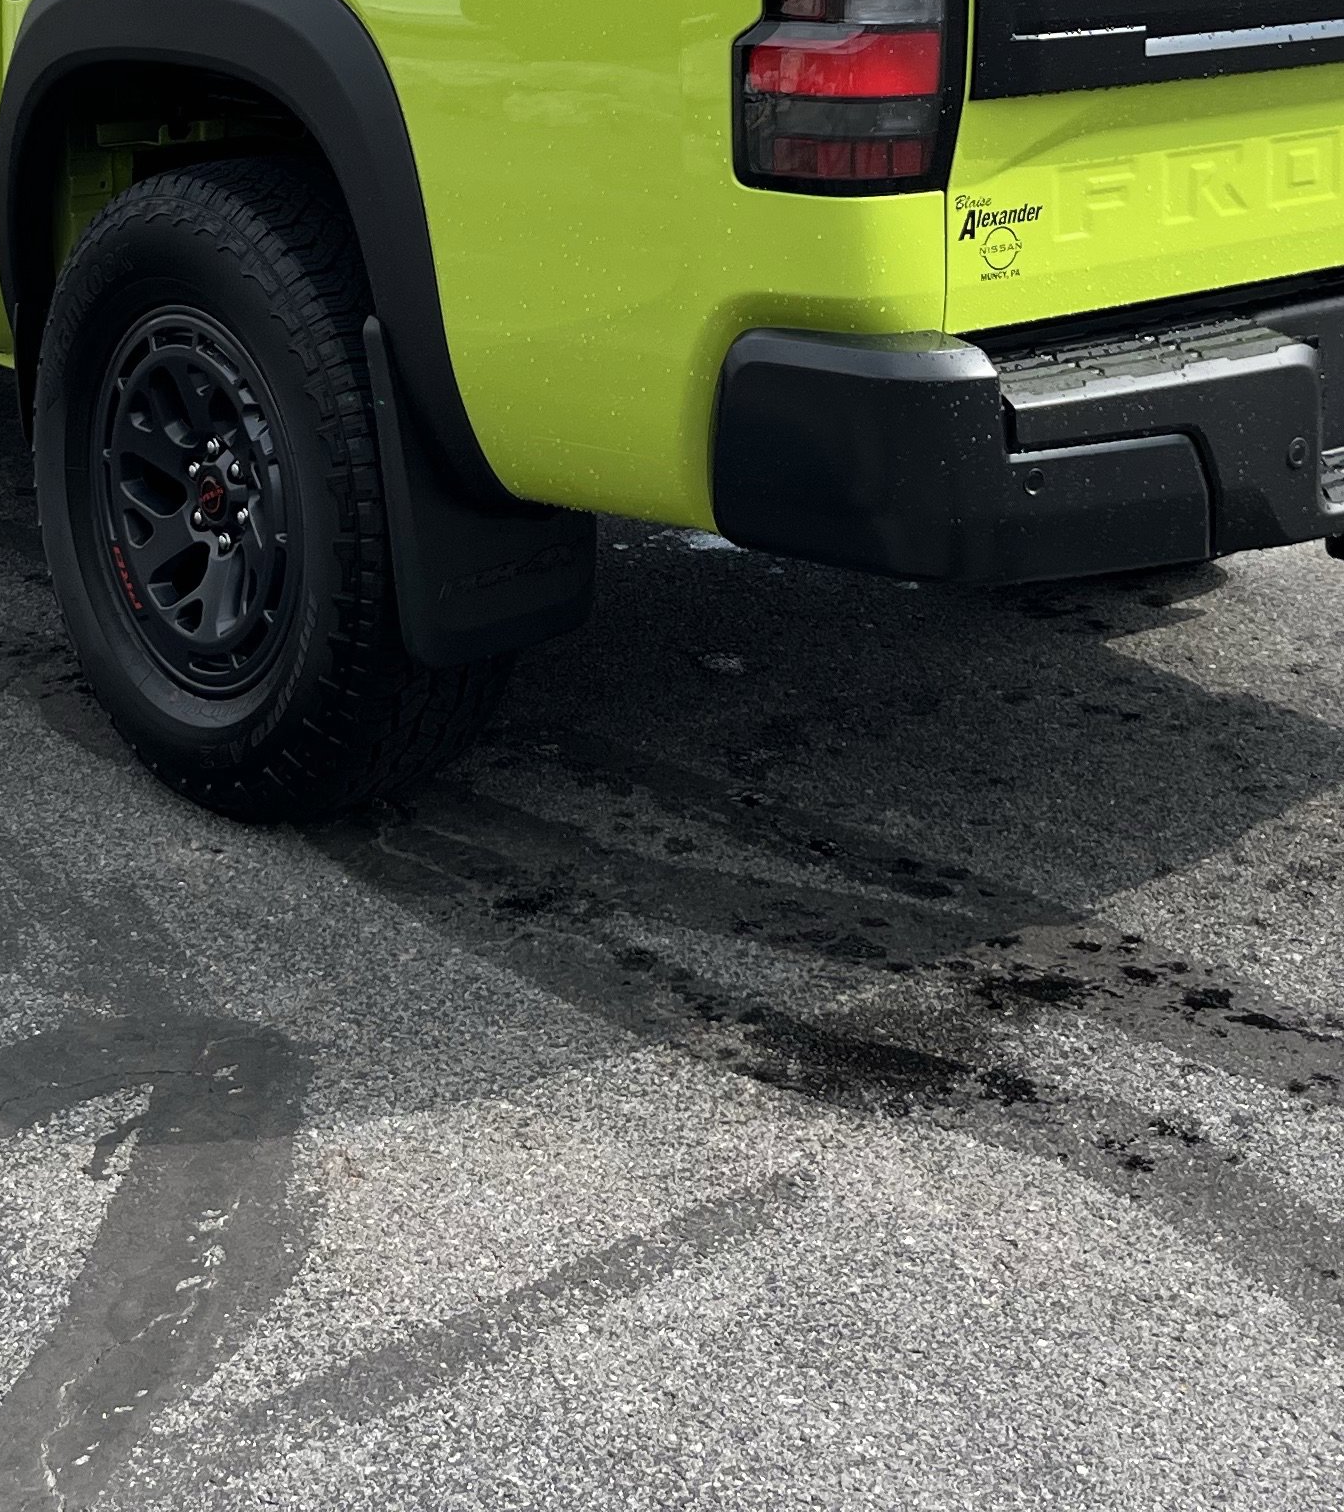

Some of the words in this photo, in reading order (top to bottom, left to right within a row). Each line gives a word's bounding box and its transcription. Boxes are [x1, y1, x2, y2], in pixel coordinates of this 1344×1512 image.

[955, 194, 992, 212] Blaise
[958, 203, 1043, 241] Alexander
[979, 242, 1022, 255] NISSAN
[1010, 269, 1020, 277] PA
